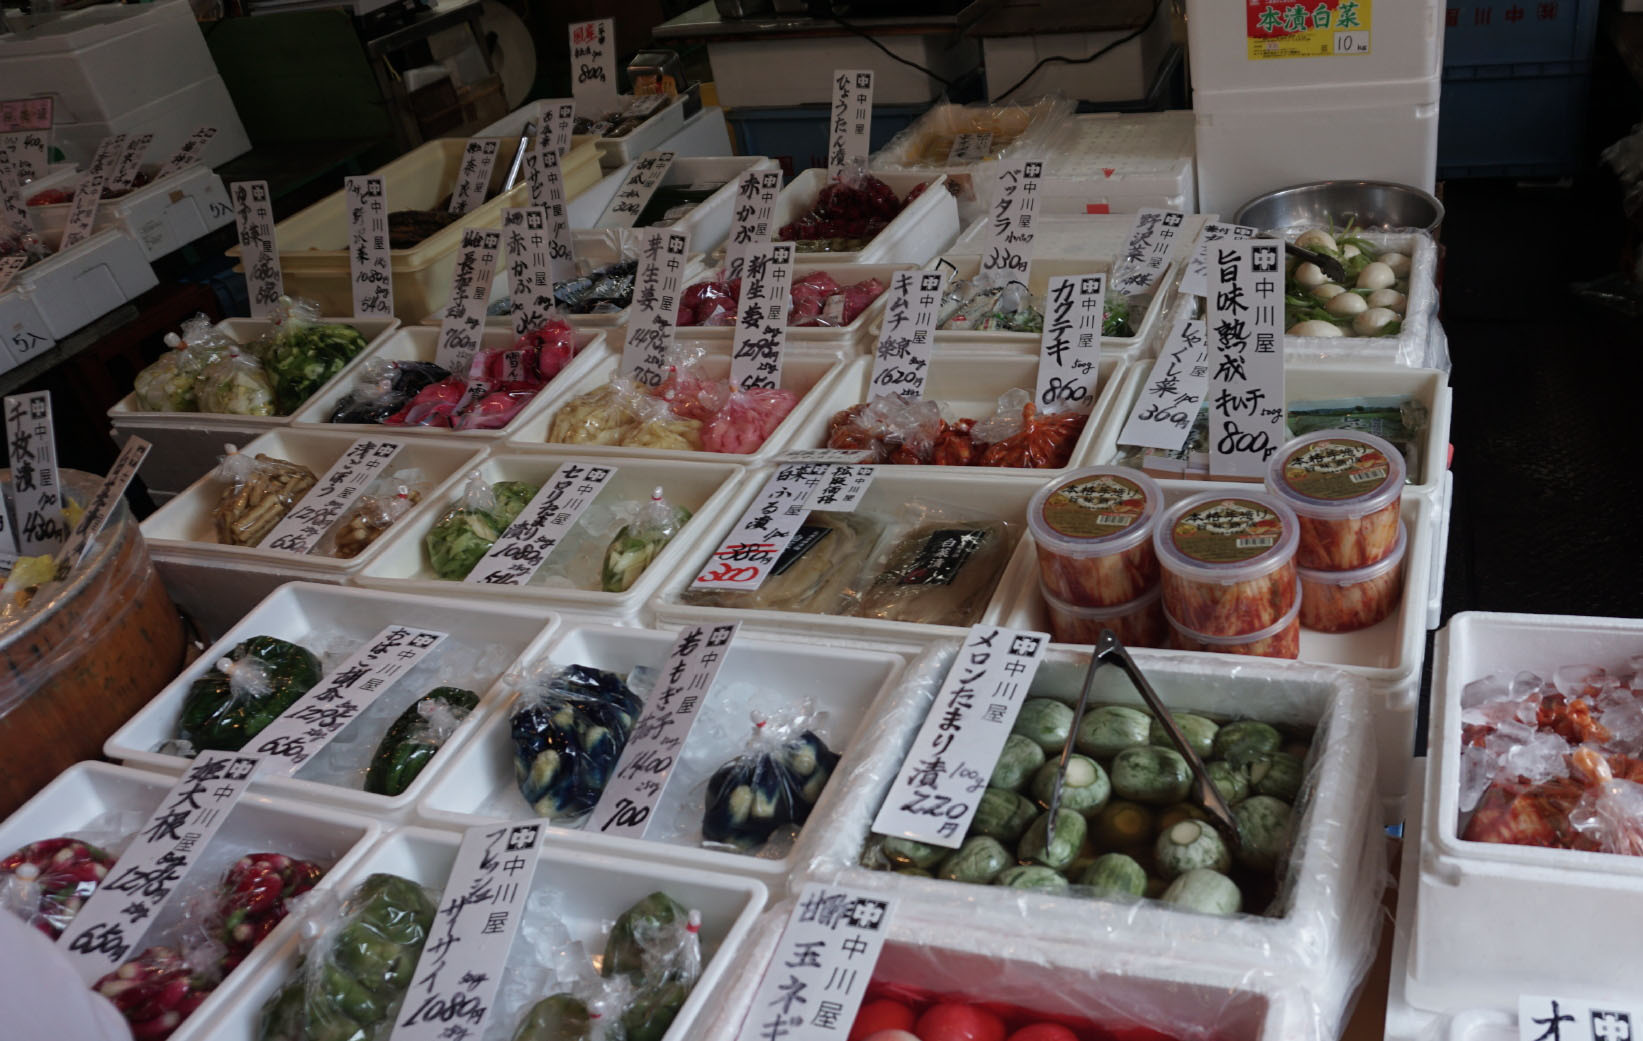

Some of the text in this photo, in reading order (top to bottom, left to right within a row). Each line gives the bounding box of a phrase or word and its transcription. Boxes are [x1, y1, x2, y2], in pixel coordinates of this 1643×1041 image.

[1257, 1, 1361, 32] 本漬白菜
[1337, 35, 1354, 52] 10
[831, 74, 850, 167] ひょうたん漬
[855, 94, 867, 134] 中川屋
[474, 157, 491, 192] 中川屋
[547, 174, 564, 217] 中川屋
[647, 162, 667, 188] 中川屋
[370, 200, 384, 250] 中川屋
[735, 173, 760, 244] 赤かぶ
[755, 192, 773, 236] 中川屋
[994, 169, 1021, 236] ベッタラ
[1019, 183, 1037, 228] 中川屋
[256, 207, 273, 252] 中川屋
[1148, 229, 1174, 269] 中川屋
[473, 252, 494, 300] 中川屋
[531, 234, 548, 286] 中川屋
[984, 247, 1028, 272] 330円
[659, 258, 680, 312] 中川屋
[741, 254, 775, 330] 新生姜
[767, 268, 786, 320] 中川屋
[888, 274, 913, 332] キムチ
[912, 294, 934, 344] 中川屋
[1046, 279, 1076, 367] カクテキ
[1078, 297, 1097, 348] 中川屋
[1255, 278, 1275, 354] 中川屋
[1149, 322, 1200, 397] しゃくし菜
[1042, 377, 1094, 406] 860円
[1138, 403, 1188, 429] 360円
[8, 400, 37, 493] 千枚漬
[34, 423, 53, 487] 中川屋
[337, 459, 381, 499] 中川屋
[843, 477, 865, 502] 中川屋
[551, 484, 594, 526] 中川屋
[697, 562, 760, 583] 300
[358, 649, 416, 692] 中川屋
[676, 651, 718, 714] 中川屋
[982, 660, 1026, 724] 中川屋
[907, 630, 999, 790] メロンたまり漬
[141, 757, 232, 843] 姫大根
[949, 762, 985, 793] 100g
[174, 784, 234, 852] 中川屋
[601, 798, 650, 832] 700
[481, 855, 527, 935] 中川屋
[811, 935, 868, 1030] 中川屋
[403, 992, 487, 1028] 1080円
